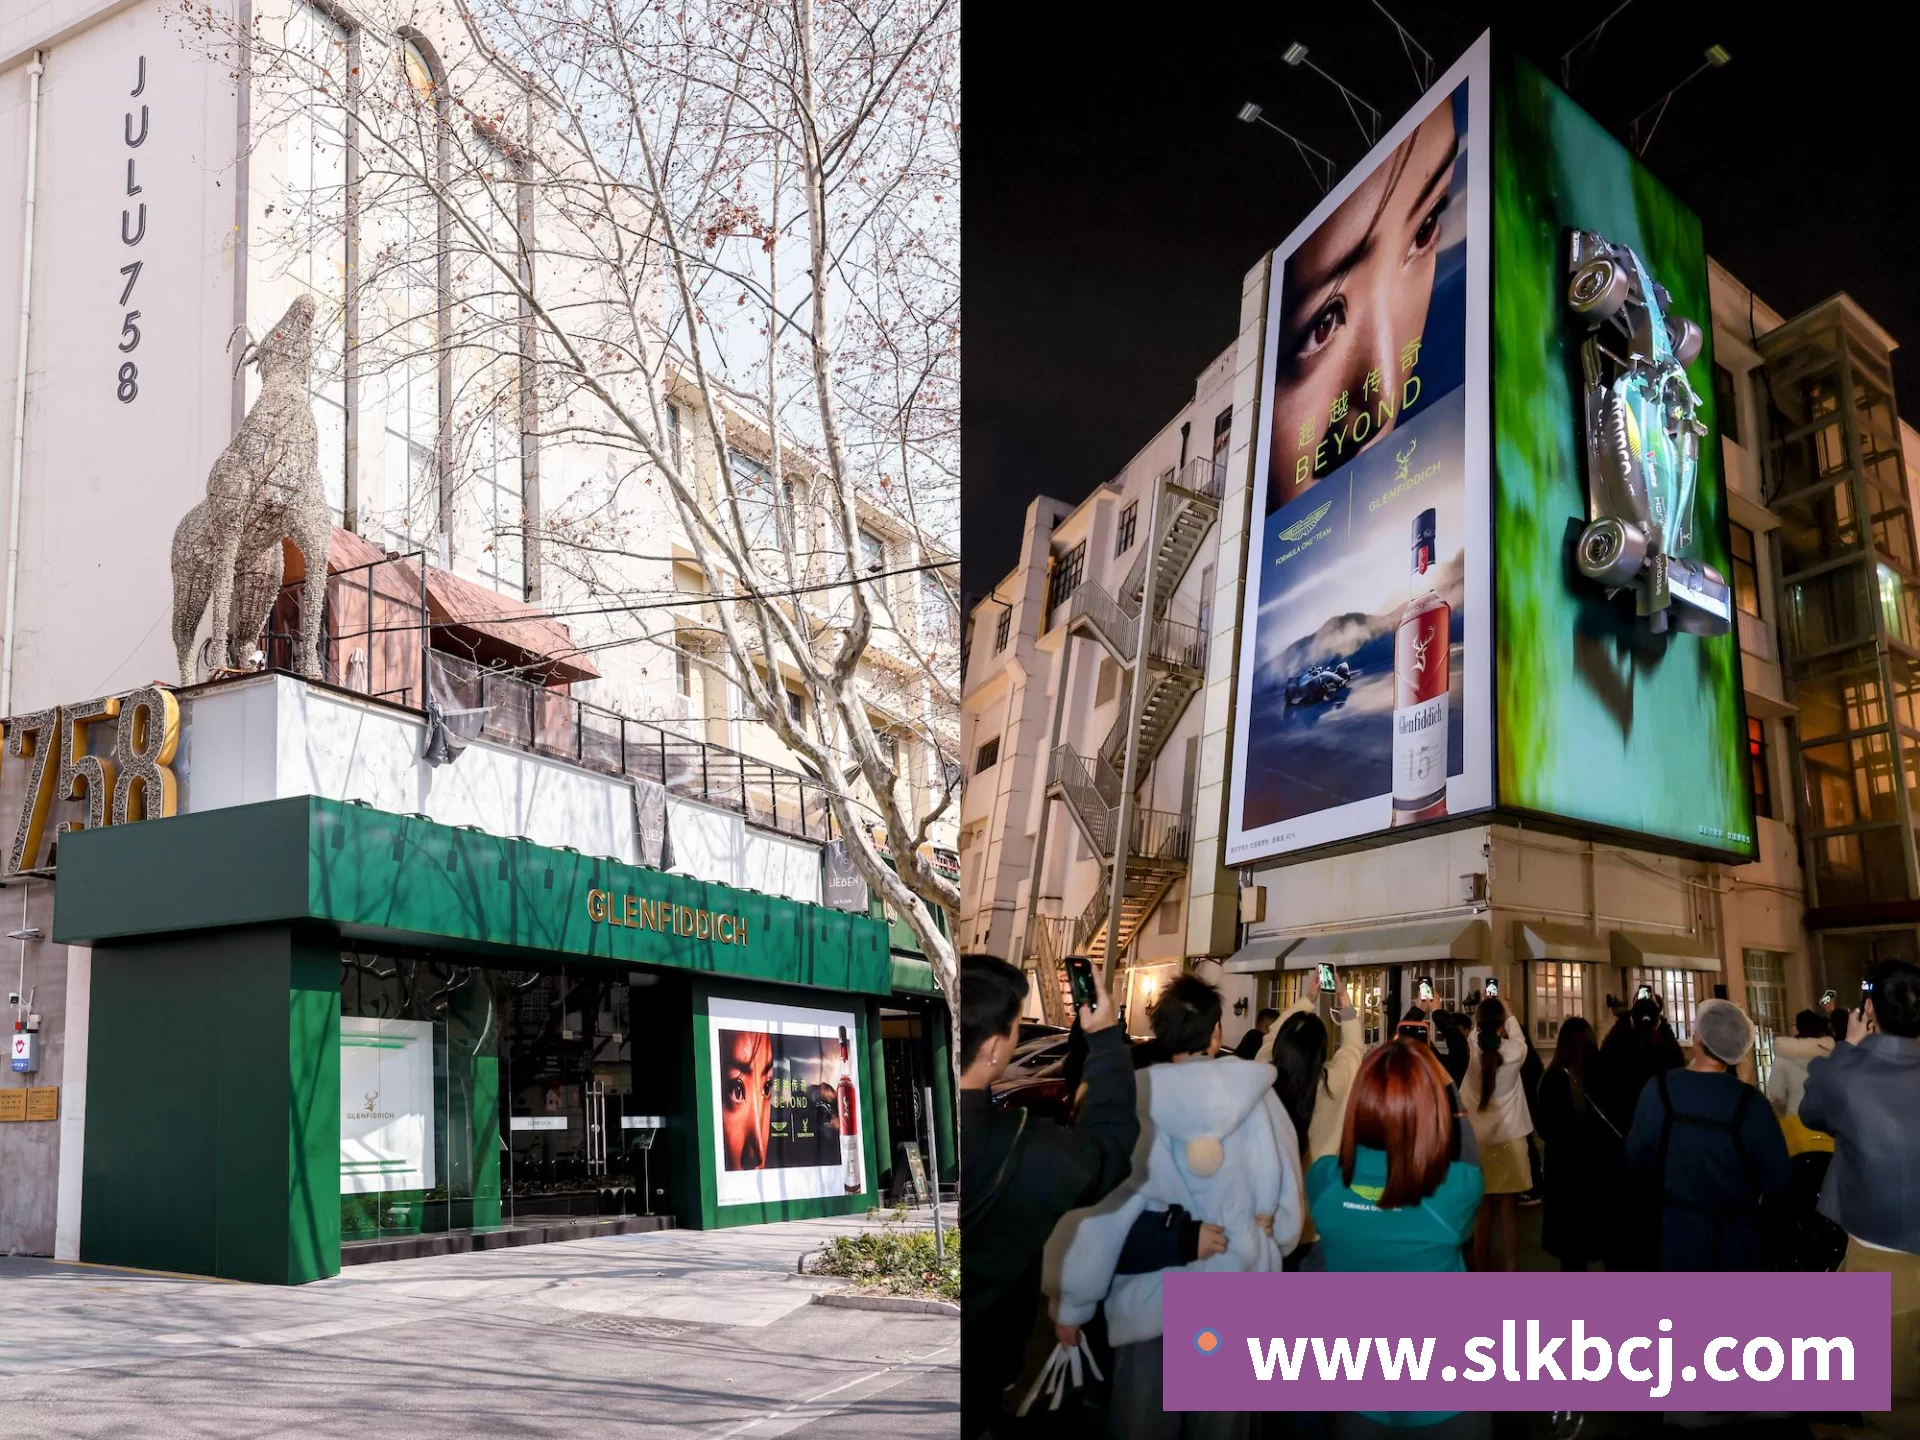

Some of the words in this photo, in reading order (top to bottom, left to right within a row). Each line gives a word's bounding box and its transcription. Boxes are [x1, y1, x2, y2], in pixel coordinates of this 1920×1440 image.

[1297, 336, 1422, 452] 超越传奇
[1295, 375, 1422, 485] BEYOND
[1368, 460, 1441, 512] GLENFIDDICH
[1275, 546, 1301, 566] FORMULA
[1316, 526, 1332, 541] TEAM
[7, 686, 181, 874] 758
[1407, 746, 1432, 781] 15
[587, 888, 749, 947] GLENFIDDICH
[346, 1111, 395, 1120] GLENFIDDICH
[773, 1096, 808, 1109] BEYOND
